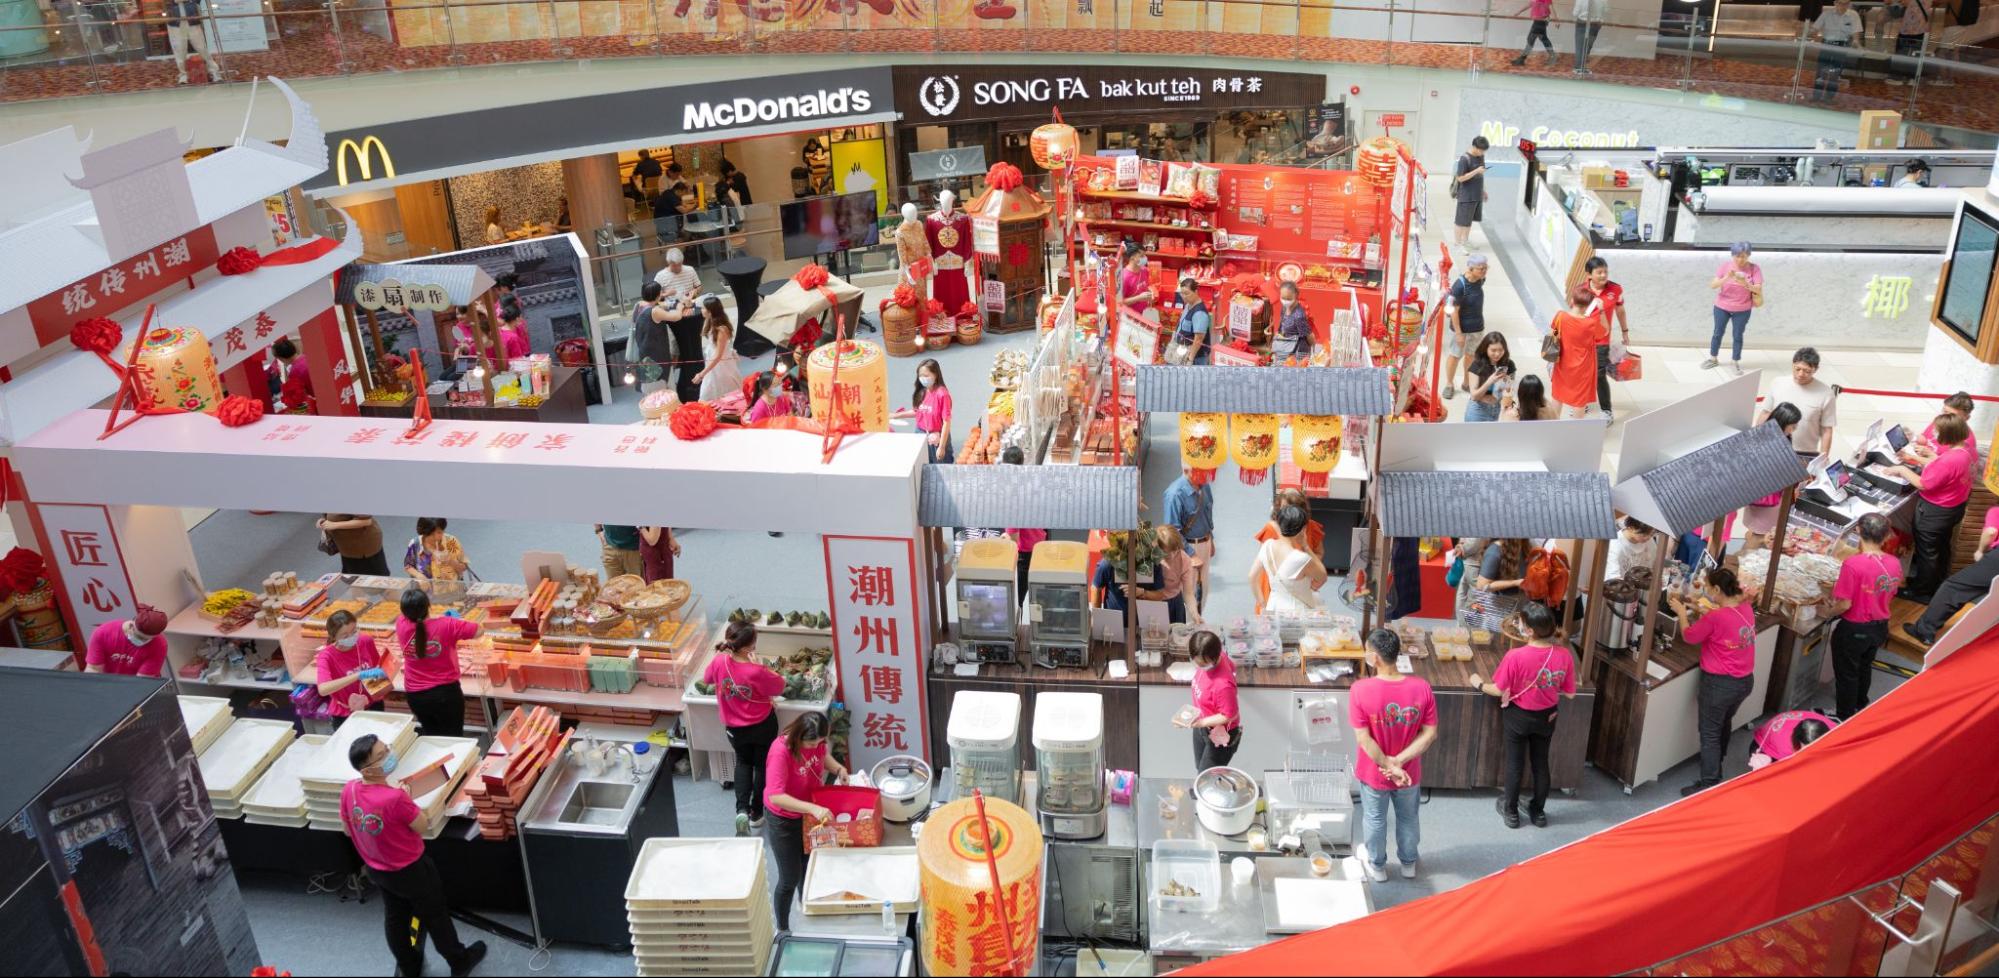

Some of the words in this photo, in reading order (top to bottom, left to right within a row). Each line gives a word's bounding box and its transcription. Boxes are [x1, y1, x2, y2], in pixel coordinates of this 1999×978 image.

[974, 79, 1051, 104] SONG
[1056, 77, 1089, 99] FA
[1100, 80, 1133, 98] bak
[1135, 79, 1165, 96] kut
[1171, 77, 1200, 95] teh
[1212, 77, 1262, 93] 肉骨茶
[683, 87, 871, 130] McDonald's
[1480, 120, 1520, 146] Mr
[1531, 125, 1640, 147] Coconut
[360, 286, 442, 306] 漆扇制作
[1862, 274, 1913, 319] 椰
[60, 530, 123, 627] 匠心
[848, 565, 909, 751] 潮州傳統
